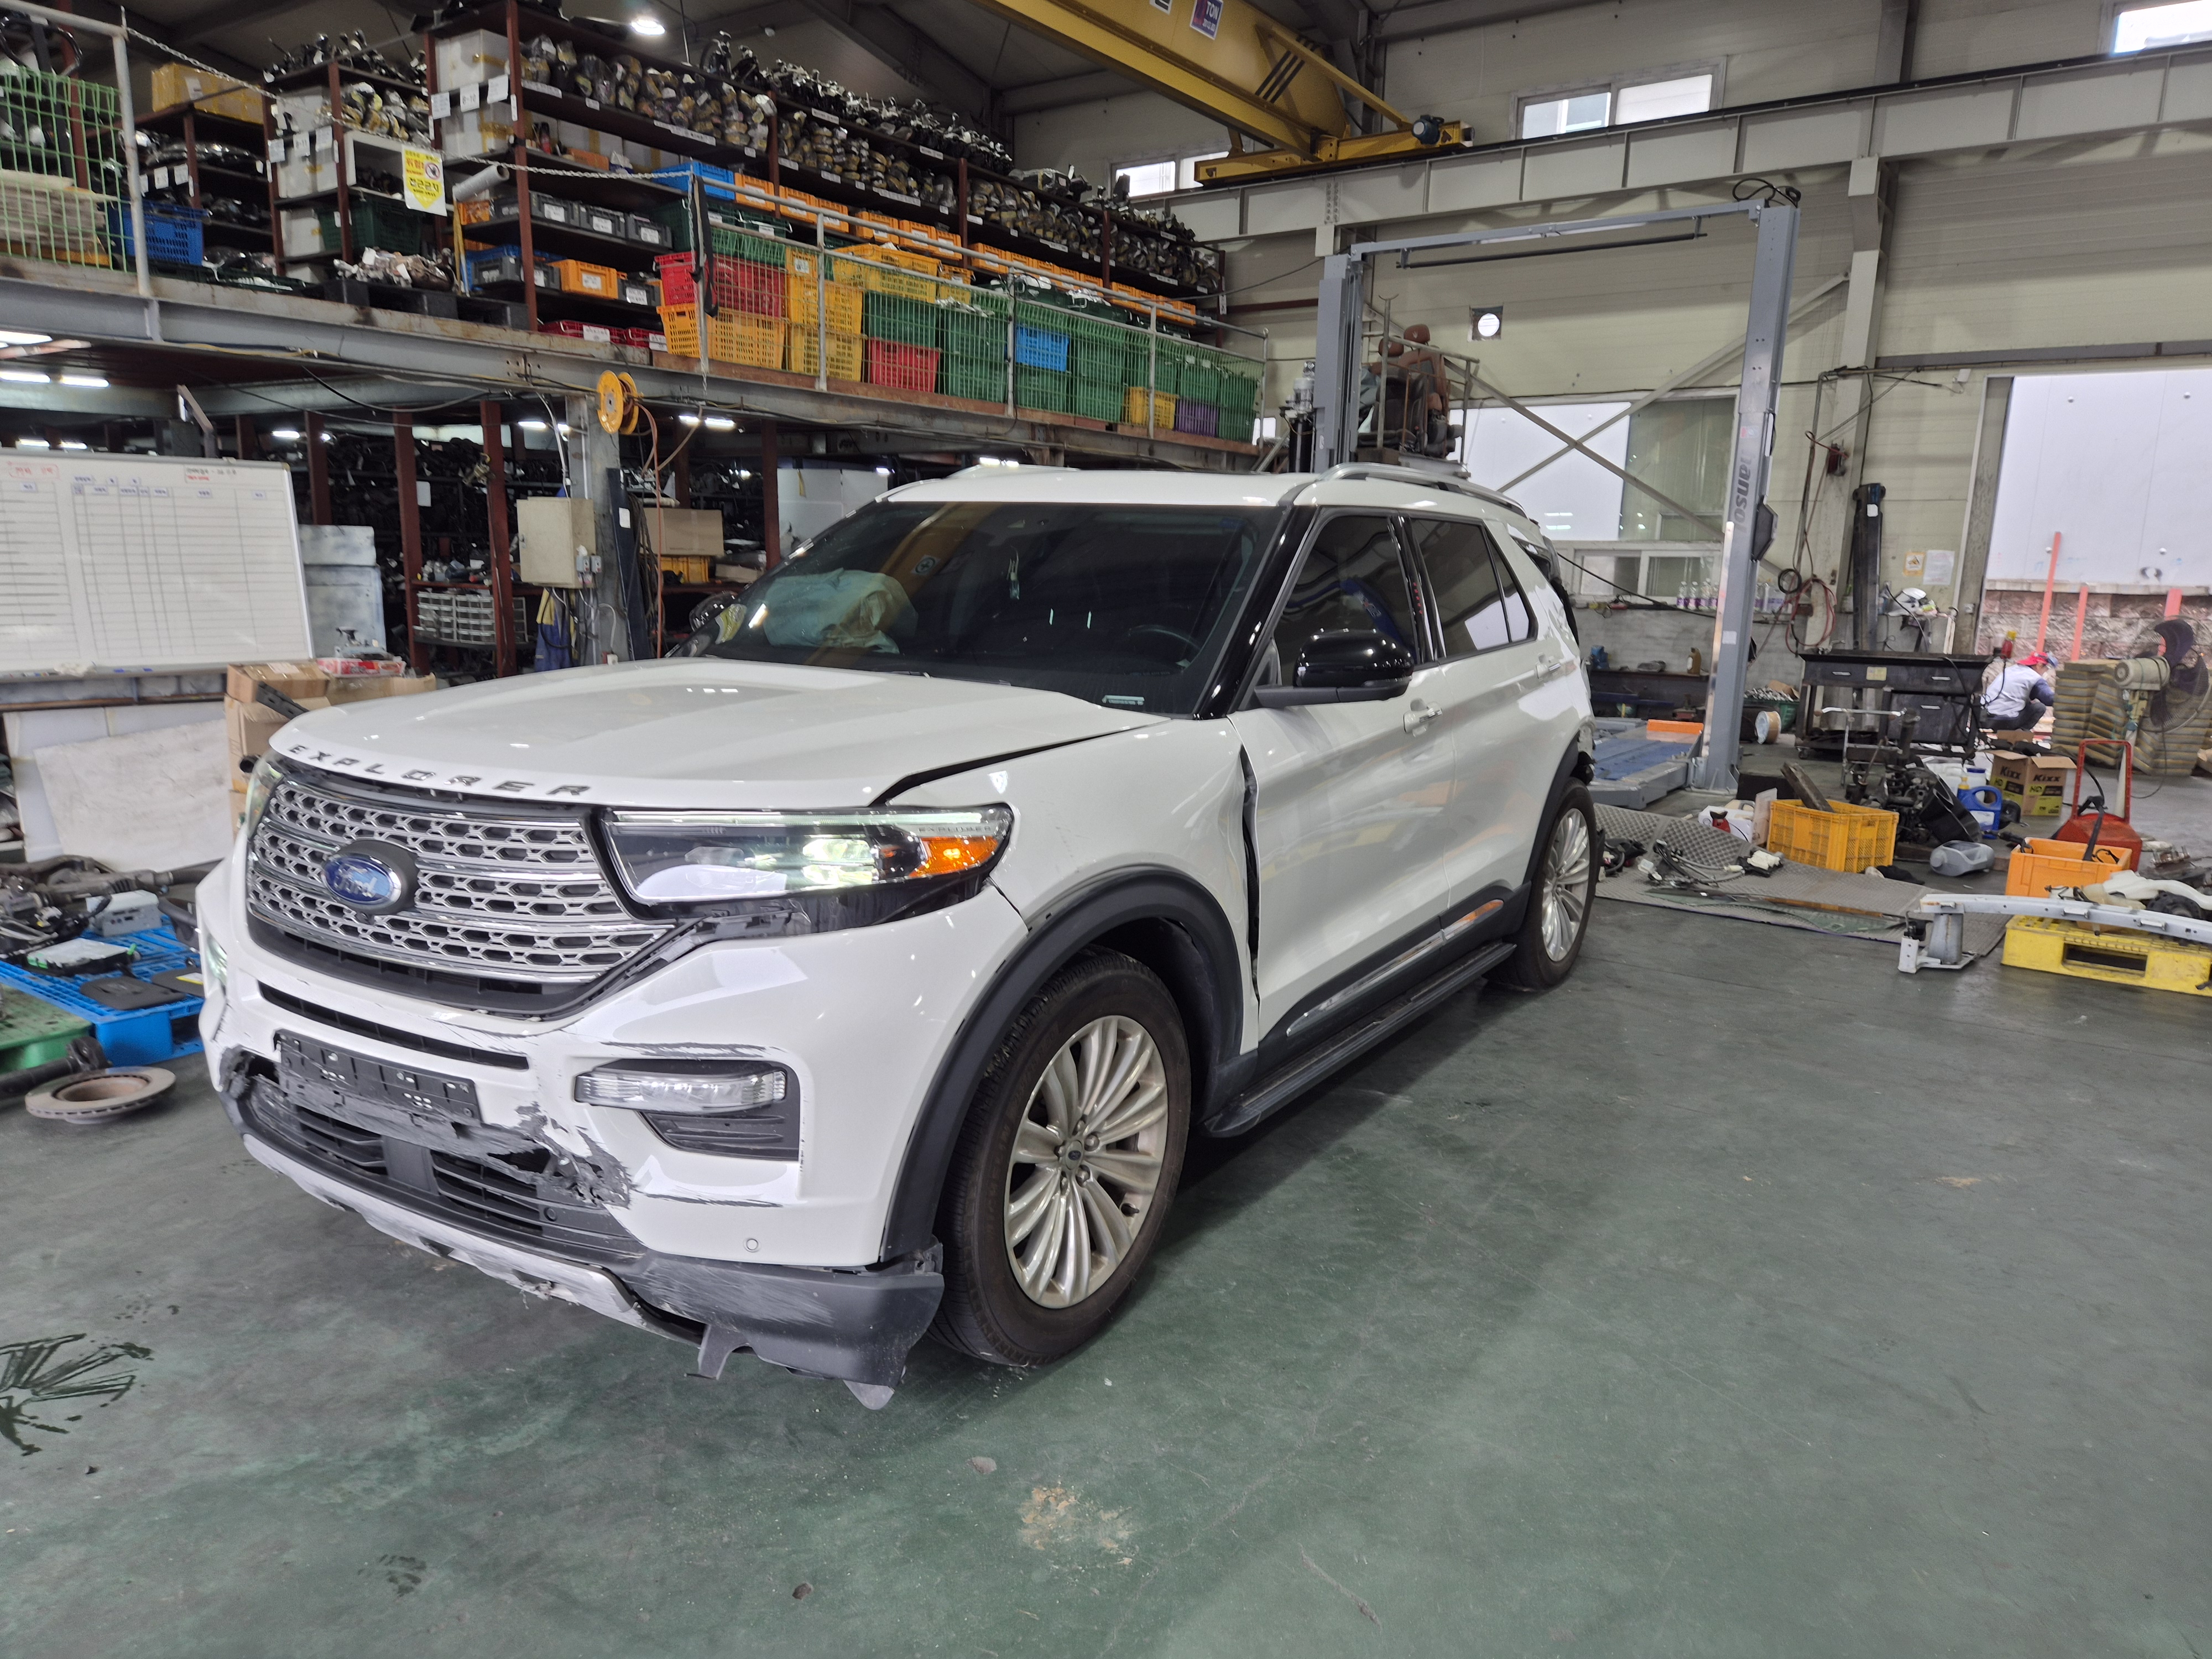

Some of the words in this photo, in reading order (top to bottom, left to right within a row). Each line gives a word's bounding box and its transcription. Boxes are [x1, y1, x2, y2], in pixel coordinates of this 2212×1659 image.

[1206, 1, 1219, 20] TON
[289, 744, 591, 796] EXPLORER
[2001, 766, 2021, 779] Kixx
[334, 863, 378, 898] Ford
